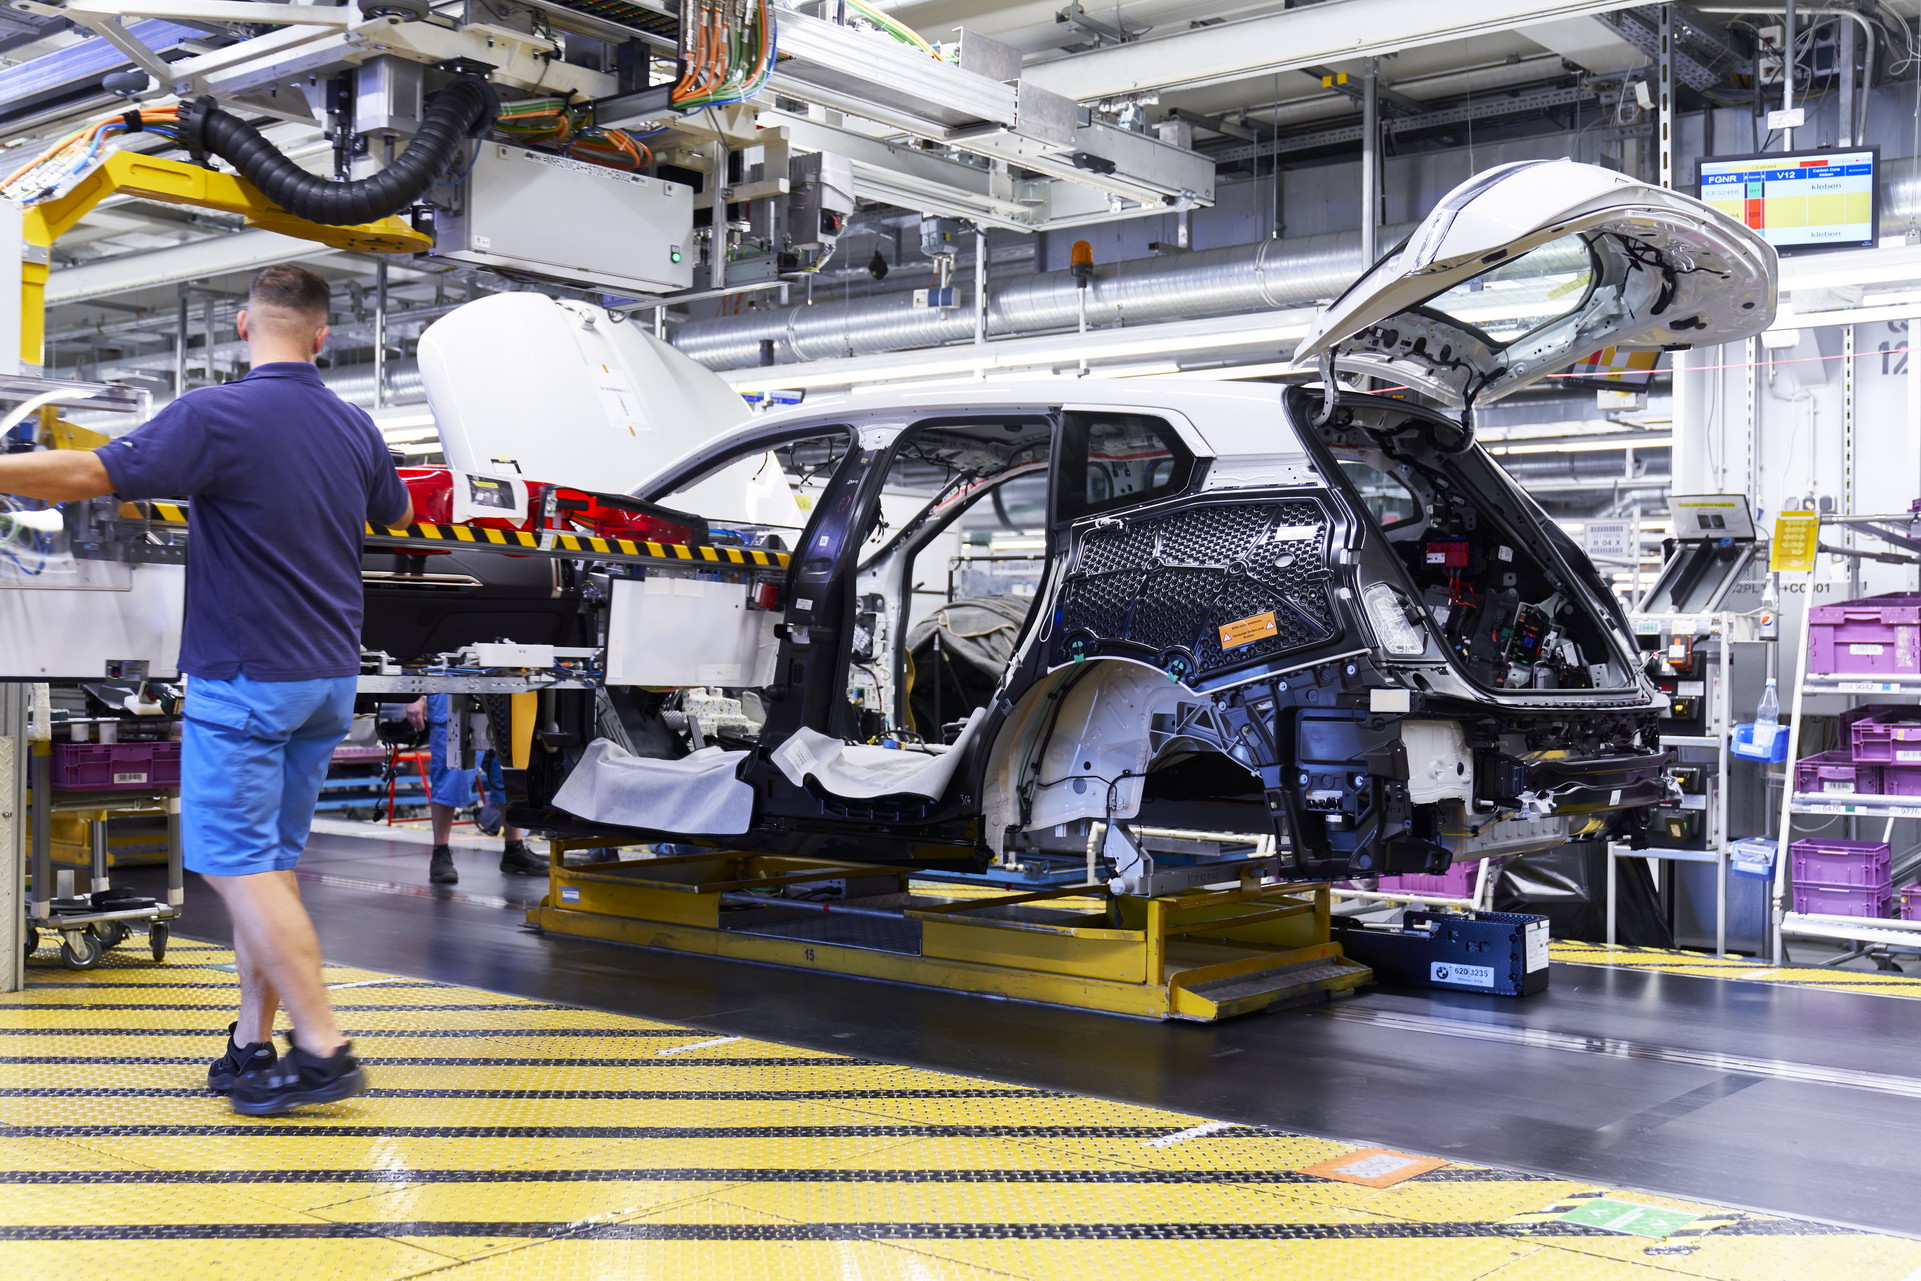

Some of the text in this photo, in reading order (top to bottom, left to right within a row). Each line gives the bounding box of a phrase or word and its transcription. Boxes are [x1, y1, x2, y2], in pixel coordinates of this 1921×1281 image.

[1708, 175, 1737, 184] FGNR
[1776, 171, 1796, 179] V12
[804, 948, 815, 962] 15
